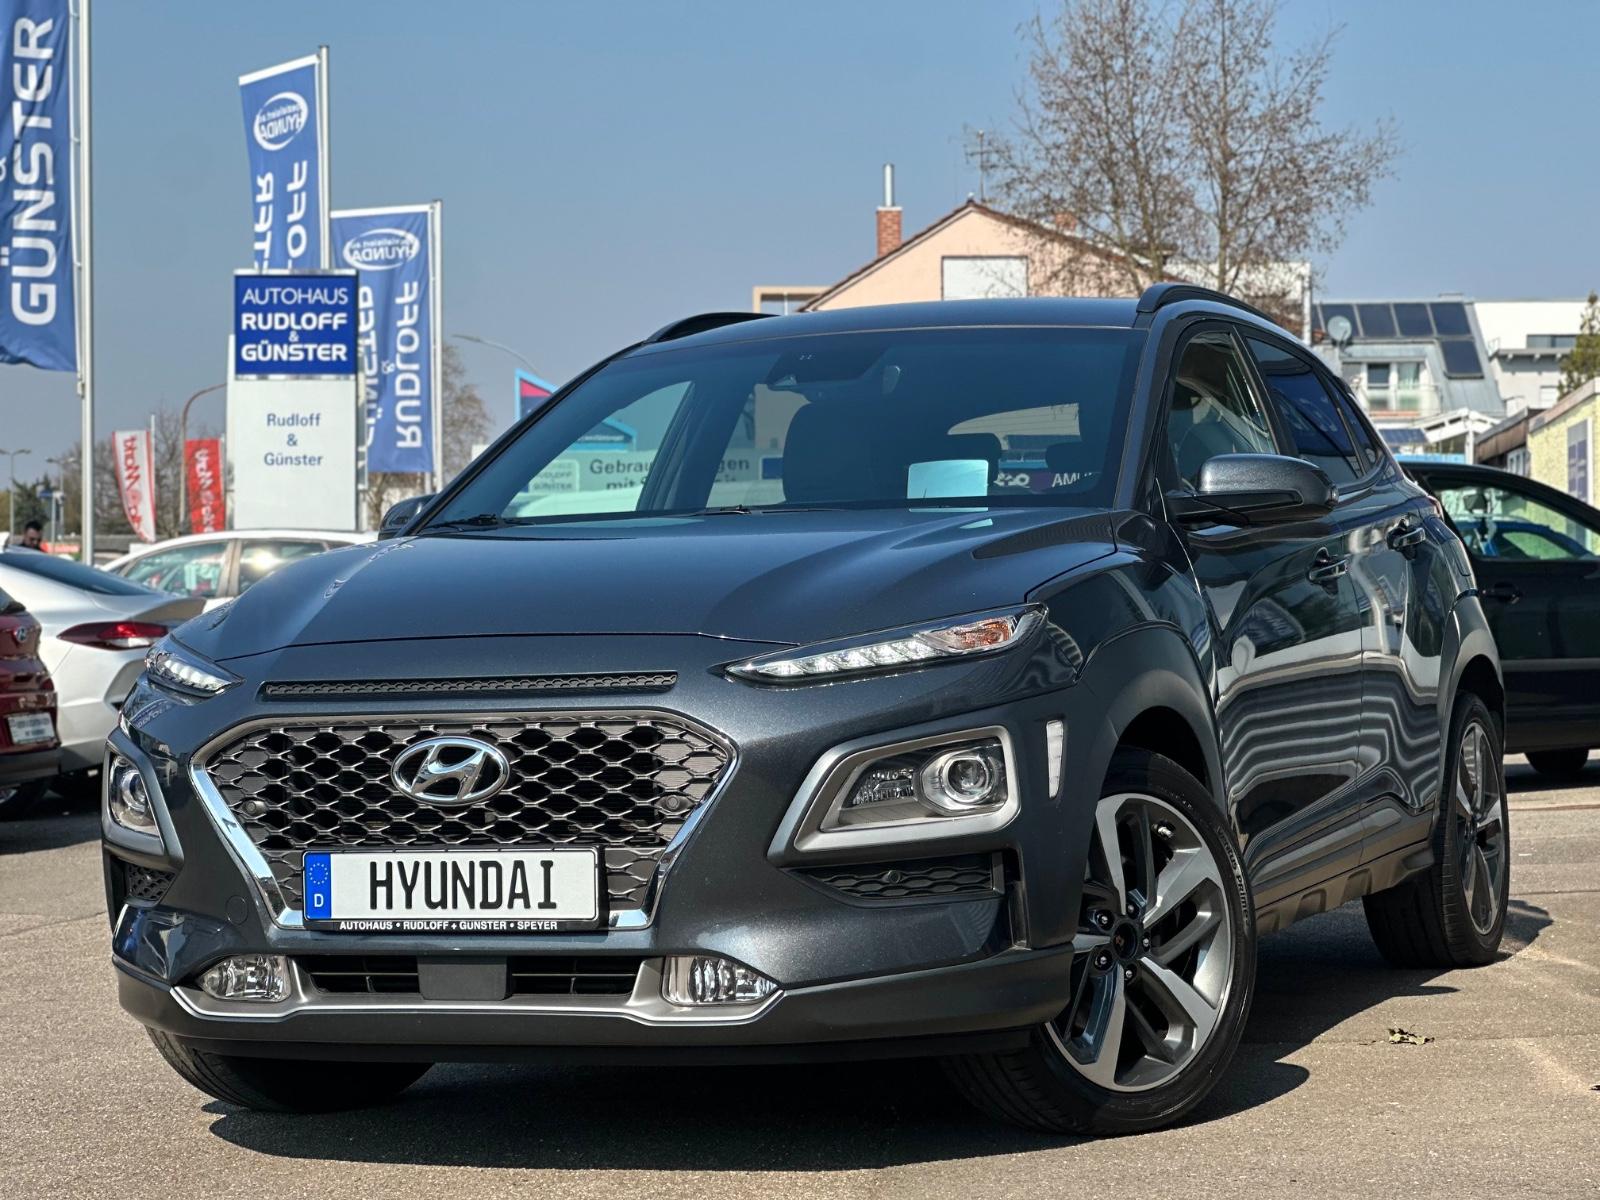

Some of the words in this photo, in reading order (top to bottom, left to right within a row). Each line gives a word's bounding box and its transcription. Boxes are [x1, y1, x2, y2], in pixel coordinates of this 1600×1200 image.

[1, 17, 57, 326] GÜNSTER
[242, 287, 349, 305] AUTOHAUS
[241, 312, 348, 331] RUDLOFF
[288, 330, 299, 342] &
[241, 339, 348, 362] GÜNSTER
[267, 412, 321, 427] Rudloff
[286, 433, 298, 447] &
[263, 451, 324, 466] Günster
[313, 893, 325, 908] D
[369, 860, 558, 910] HYUNDAI
[340, 921, 393, 930] AUTOHAUS
[403, 921, 449, 930] RUDLOFF
[517, 921, 558, 931] SPEYER
